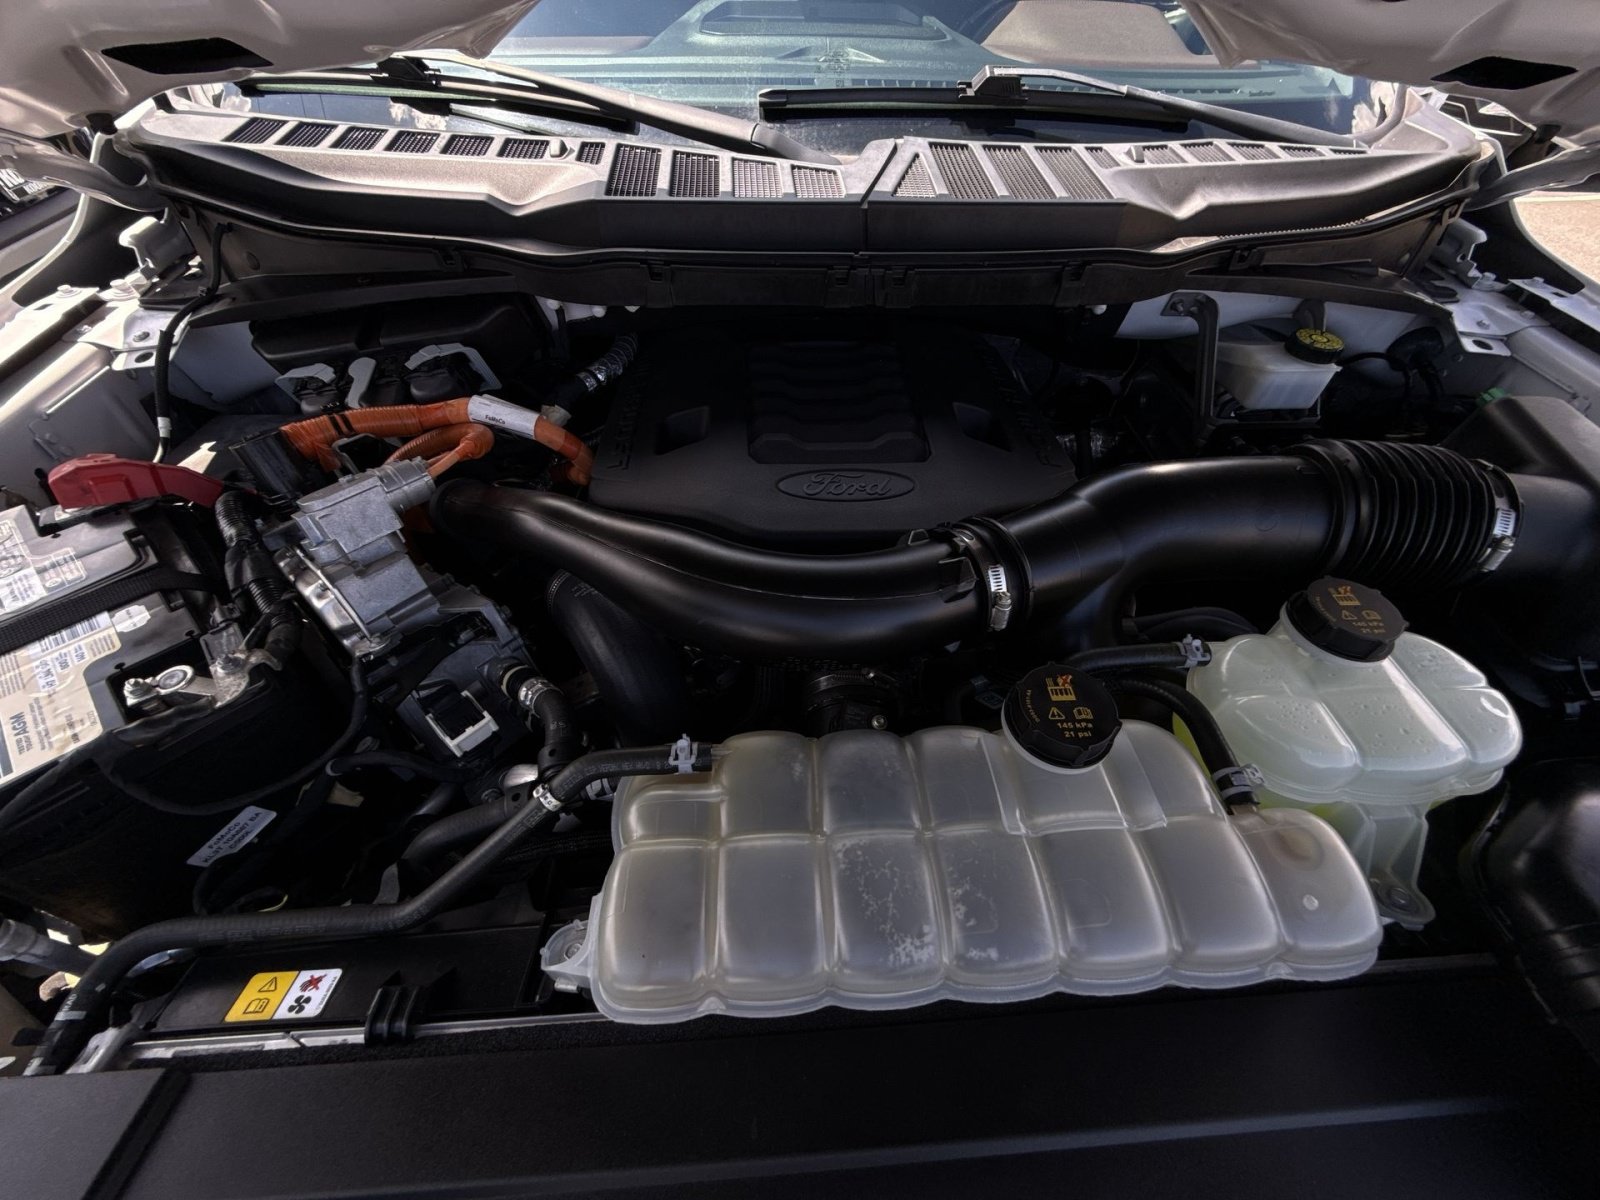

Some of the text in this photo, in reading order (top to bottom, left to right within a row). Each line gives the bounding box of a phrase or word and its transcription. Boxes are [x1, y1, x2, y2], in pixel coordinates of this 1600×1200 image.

[485, 414, 506, 425] FoMoCo
[803, 472, 893, 496] Ford
[8, 710, 28, 737] AGM
[208, 821, 241, 849] FoMoCo
